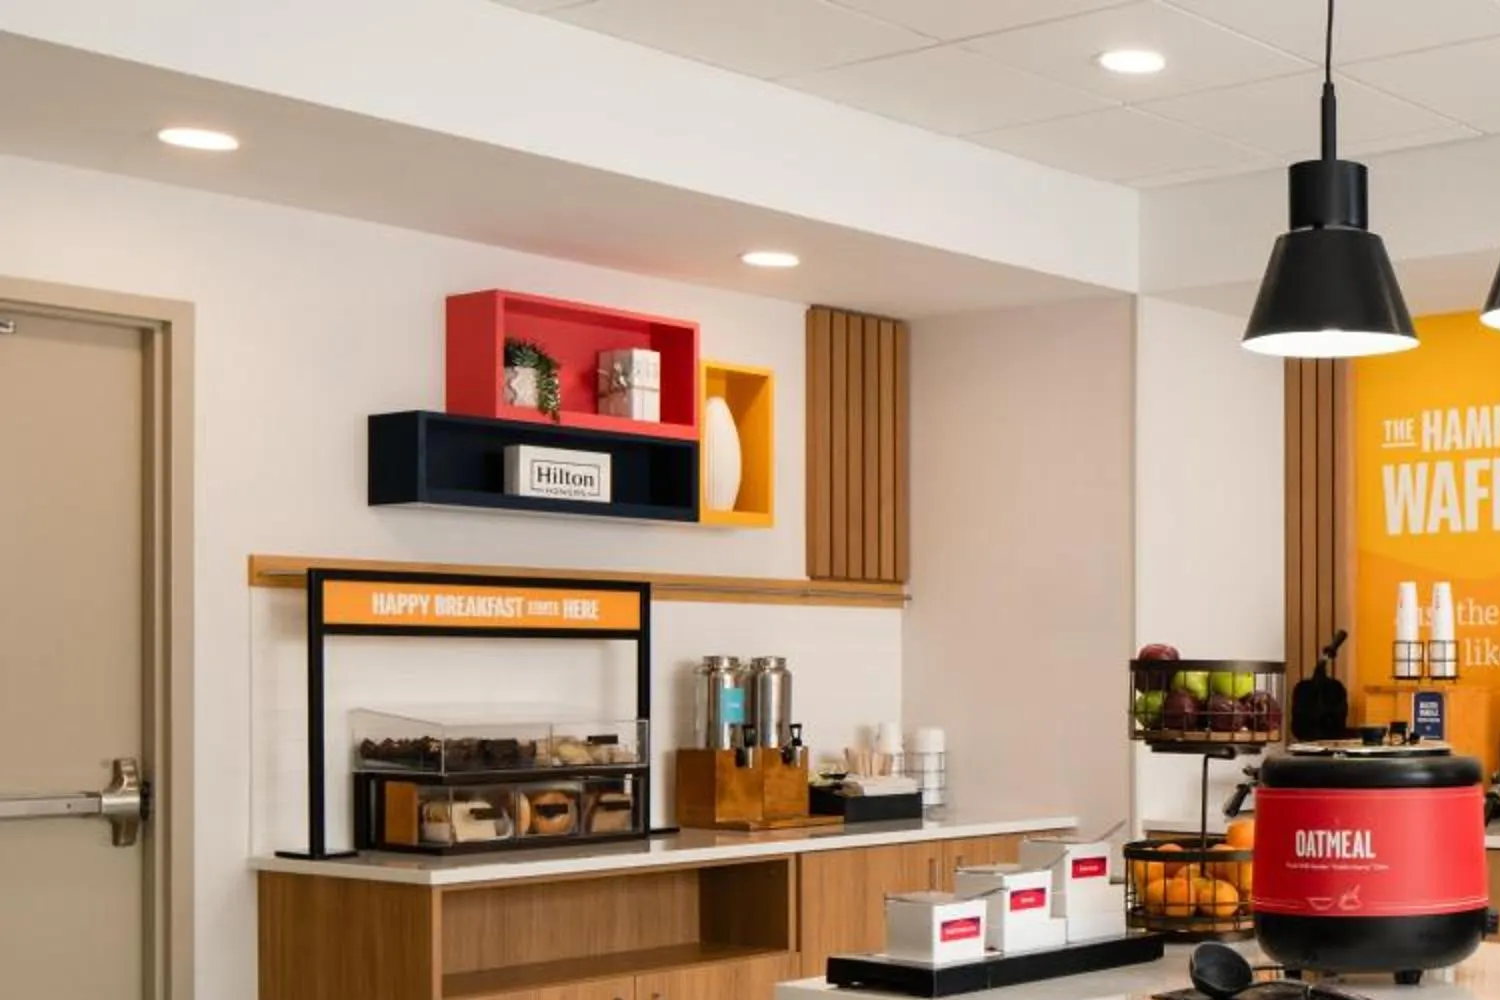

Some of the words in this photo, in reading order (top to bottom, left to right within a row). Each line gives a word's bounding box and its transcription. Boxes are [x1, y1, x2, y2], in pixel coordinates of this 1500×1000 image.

[1382, 418, 1414, 442] THE
[537, 466, 594, 487] Hilton
[372, 592, 430, 615] HAPPY
[435, 594, 523, 618] BREAKFAST
[563, 598, 599, 620] HERE
[1456, 598, 1500, 626] the
[1295, 829, 1377, 858] OATMEAL
